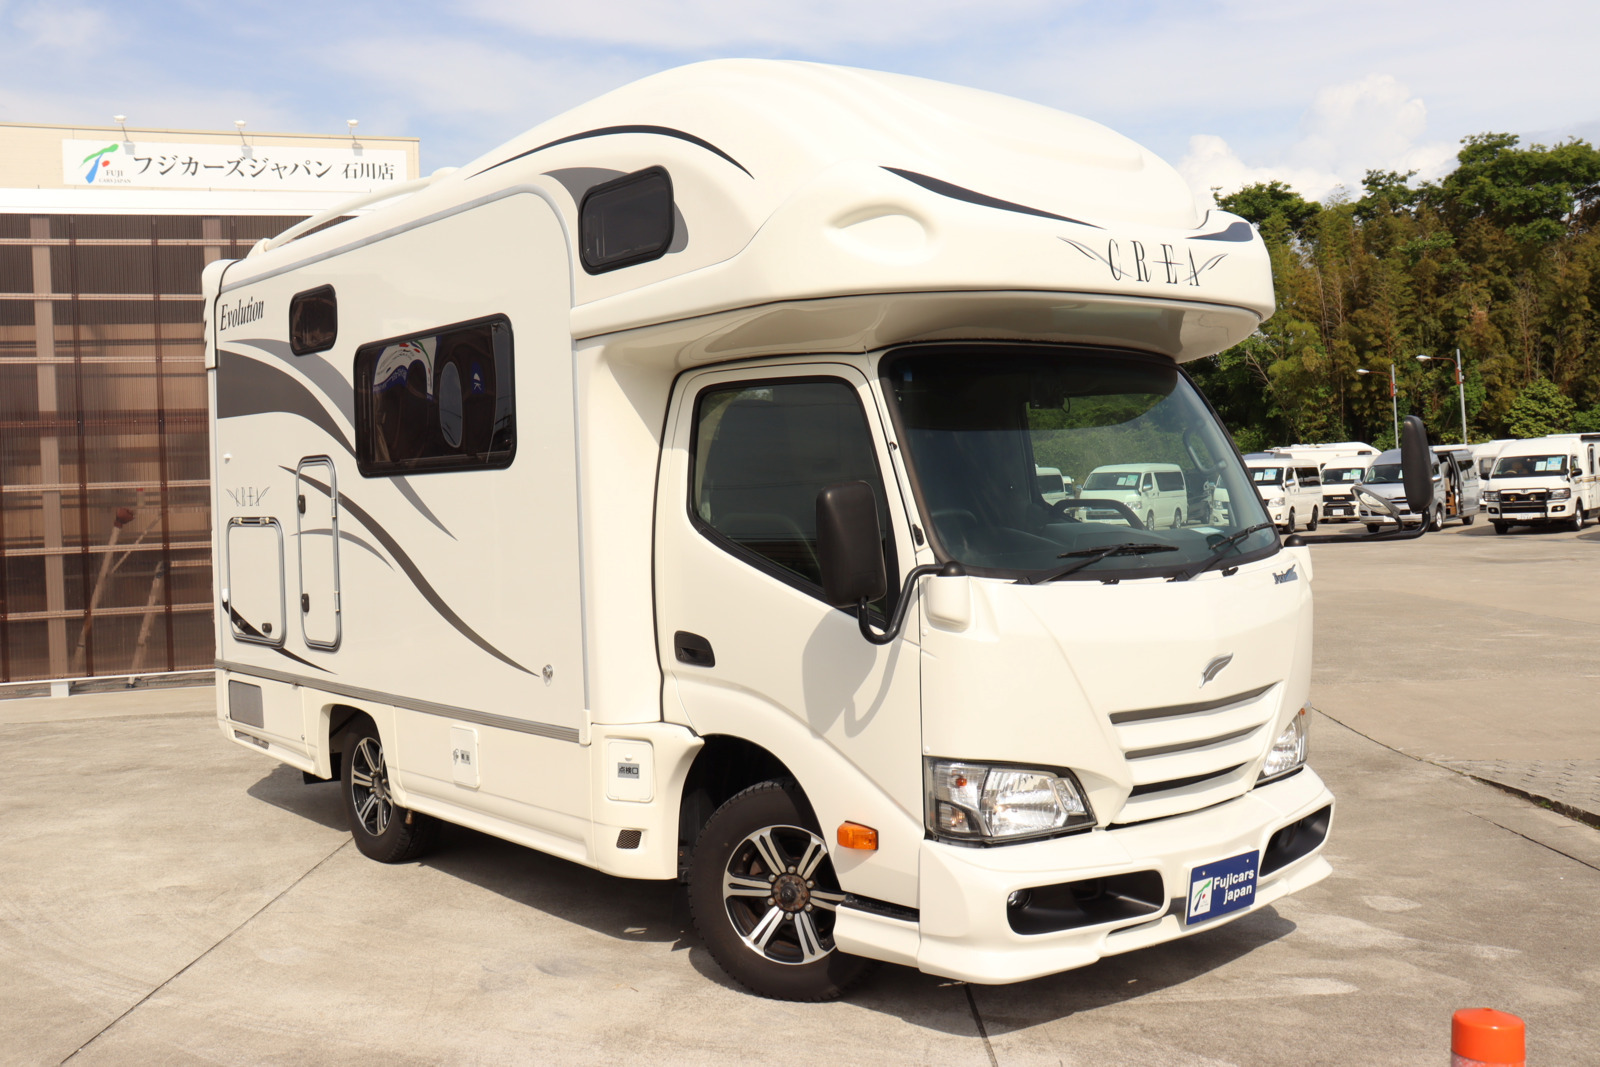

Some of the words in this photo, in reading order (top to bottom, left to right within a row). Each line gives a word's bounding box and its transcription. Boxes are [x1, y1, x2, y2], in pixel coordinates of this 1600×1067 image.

[105, 169, 124, 178] FUJI
[133, 155, 332, 179] フジカーズジャパン
[341, 162, 395, 181] 石川店
[1106, 238, 1202, 287] CREA
[219, 296, 265, 331] Evolution
[619, 766, 639, 775] 点検口
[1213, 869, 1255, 890] Fujicars
